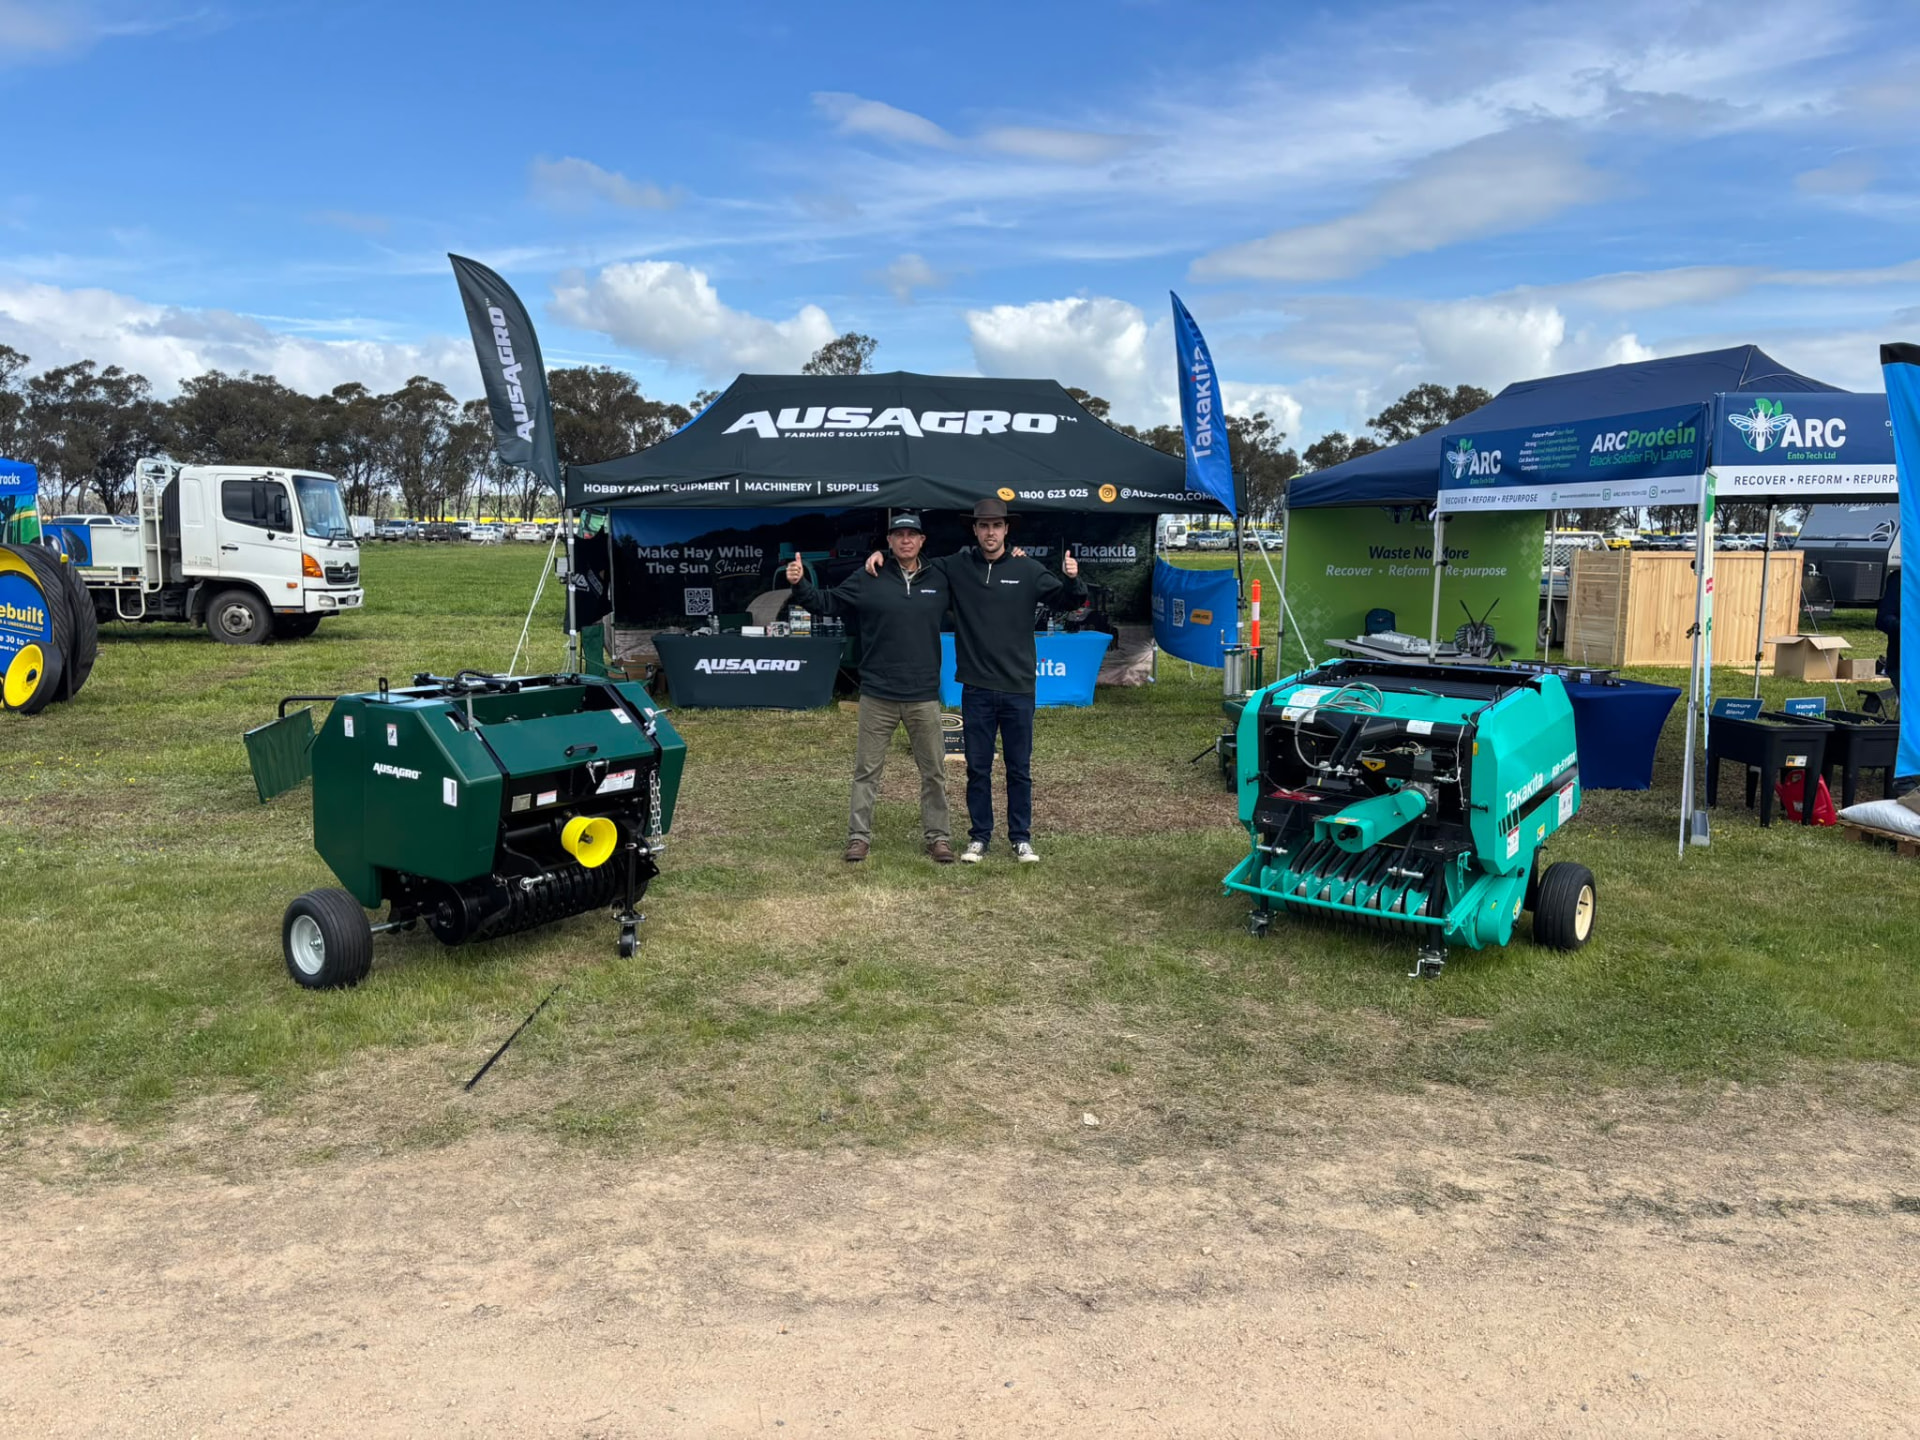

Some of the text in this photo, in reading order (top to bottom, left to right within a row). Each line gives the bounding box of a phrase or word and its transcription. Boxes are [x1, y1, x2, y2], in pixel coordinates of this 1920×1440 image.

[784, 430, 900, 439] FARMING SOLUTIONS
[1780, 417, 1847, 448] ARC
[1590, 447, 1694, 467] Black Soldier Fly Larvae
[1787, 451, 1837, 460] Ento Tech Ltd
[1469, 450, 1501, 476] ARC
[583, 481, 880, 493] HOBBY FARM EQUIPMENT MACHINERY SUPPLIES
[1734, 475, 1787, 485] RECOVER
[1797, 475, 1842, 484] REFORM
[1018, 488, 1089, 499] 1800 623 025
[1472, 494, 1497, 504] REFORM
[1502, 493, 1538, 504] REPURPOSE
[637, 545, 763, 561] Make Hay While
[1072, 543, 1136, 557] Takakita
[1369, 546, 1411, 559] Waste
[1413, 546, 1432, 559] No
[646, 559, 761, 574] The Sun Shines!
[1326, 564, 1507, 578] Recover Reform Re-purpose
[1505, 773, 1544, 813] Takakita
